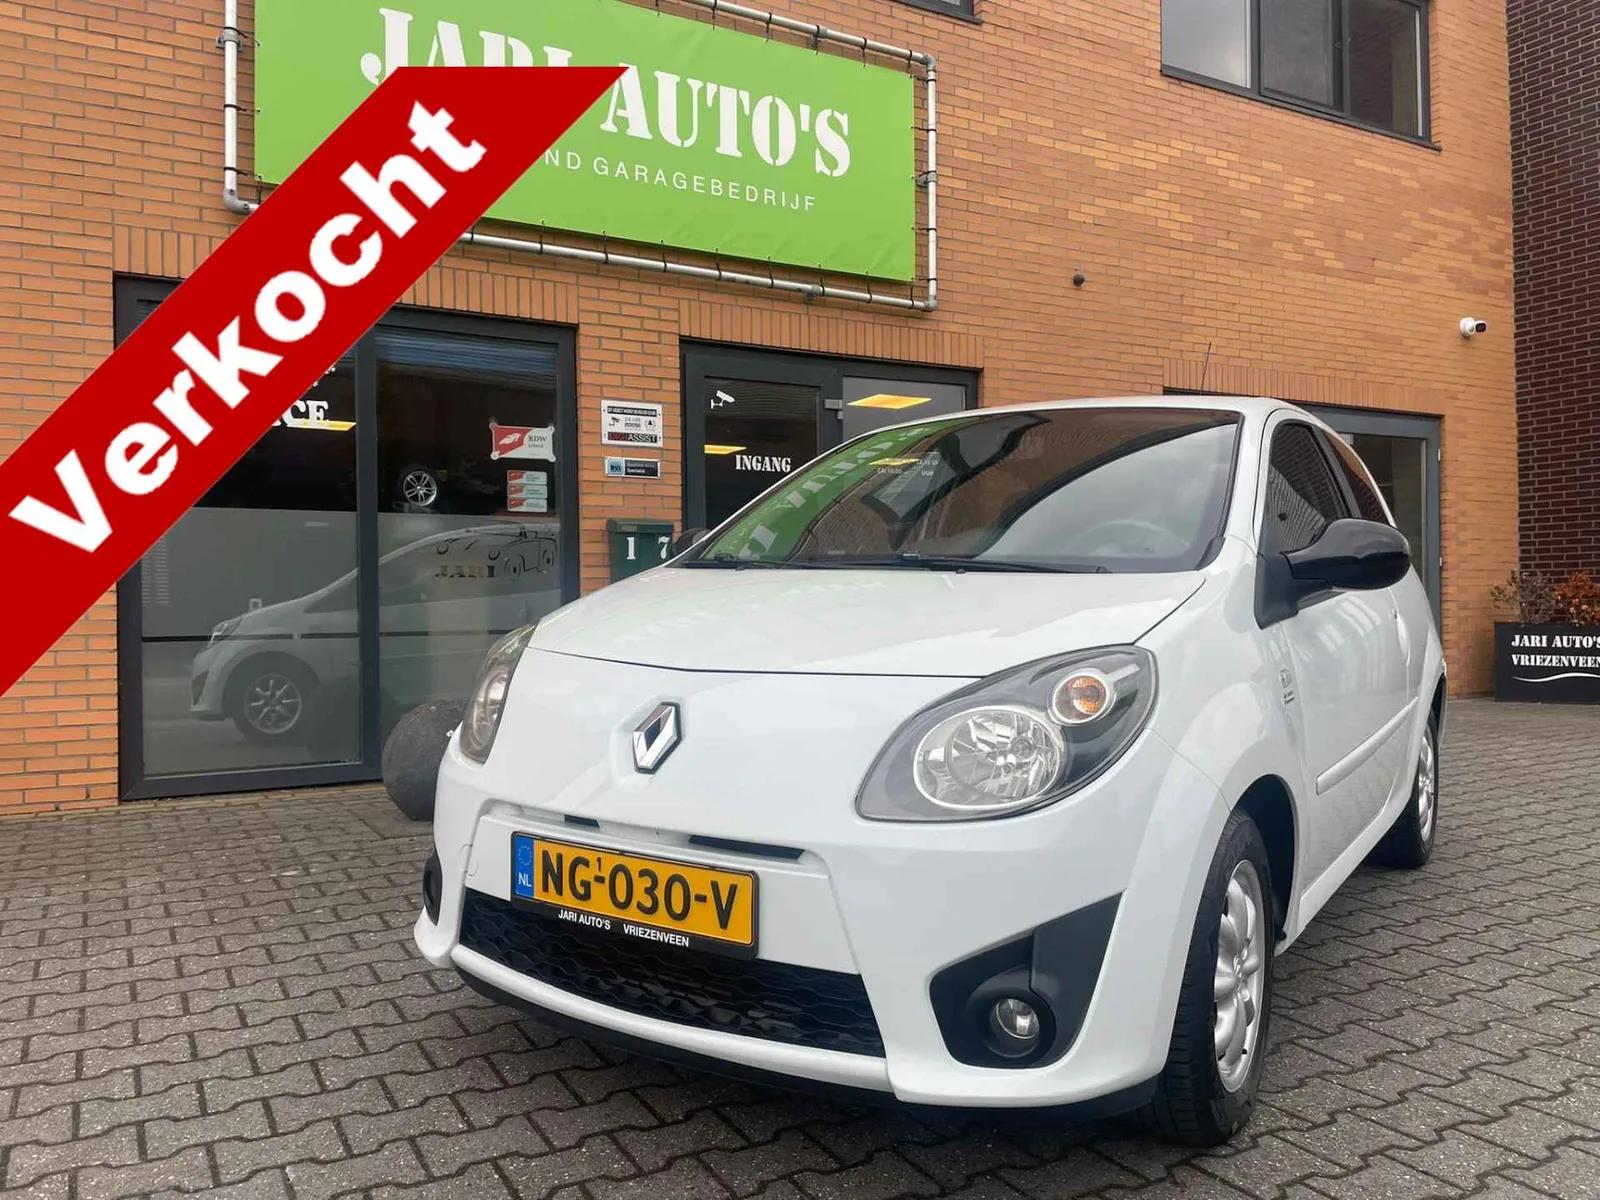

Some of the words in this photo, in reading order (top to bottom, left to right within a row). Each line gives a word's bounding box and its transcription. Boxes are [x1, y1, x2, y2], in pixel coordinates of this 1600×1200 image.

[360, 8, 573, 86] JA
[600, 62, 850, 178] AUTO'S
[593, 157, 815, 212] GARAGEBEDRIJF
[735, 454, 791, 473] INGANG
[1511, 634, 1547, 648] JARI
[518, 872, 532, 889] NL
[558, 908, 577, 923] JARI
[578, 914, 611, 931] AUTO'S
[623, 923, 689, 948] VRIEZENVEEN
